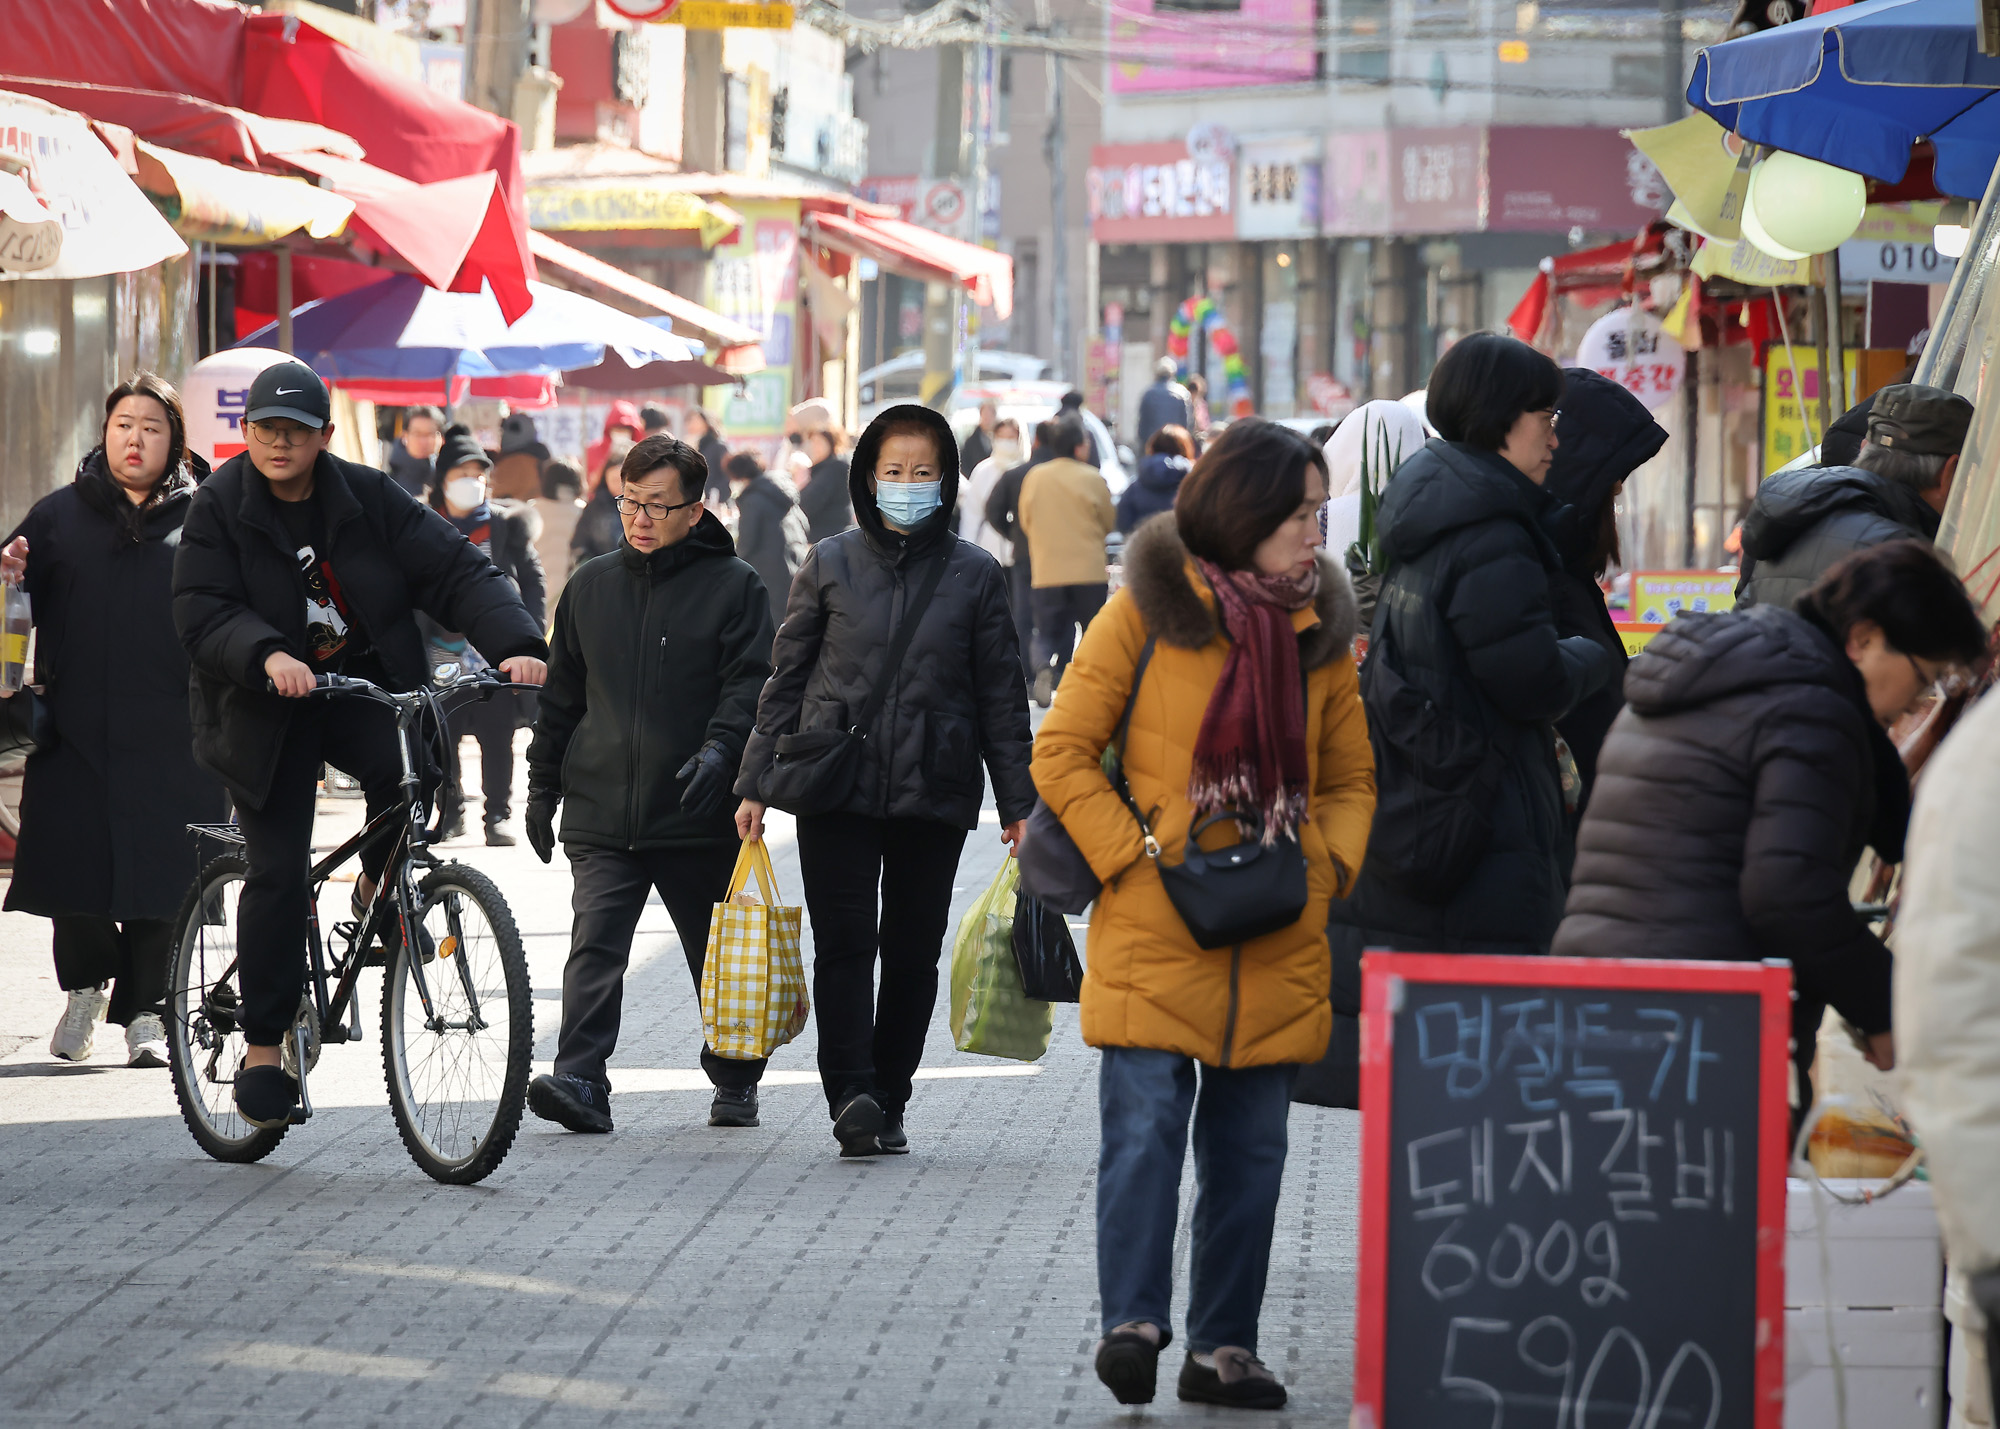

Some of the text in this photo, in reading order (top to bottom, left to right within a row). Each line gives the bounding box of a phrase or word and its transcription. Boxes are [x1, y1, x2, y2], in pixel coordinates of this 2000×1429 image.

[1416, 995, 1721, 1110] 명절특가
[1407, 1108, 1734, 1222] 돼지갈비
[1421, 1218, 1631, 1307] 600g
